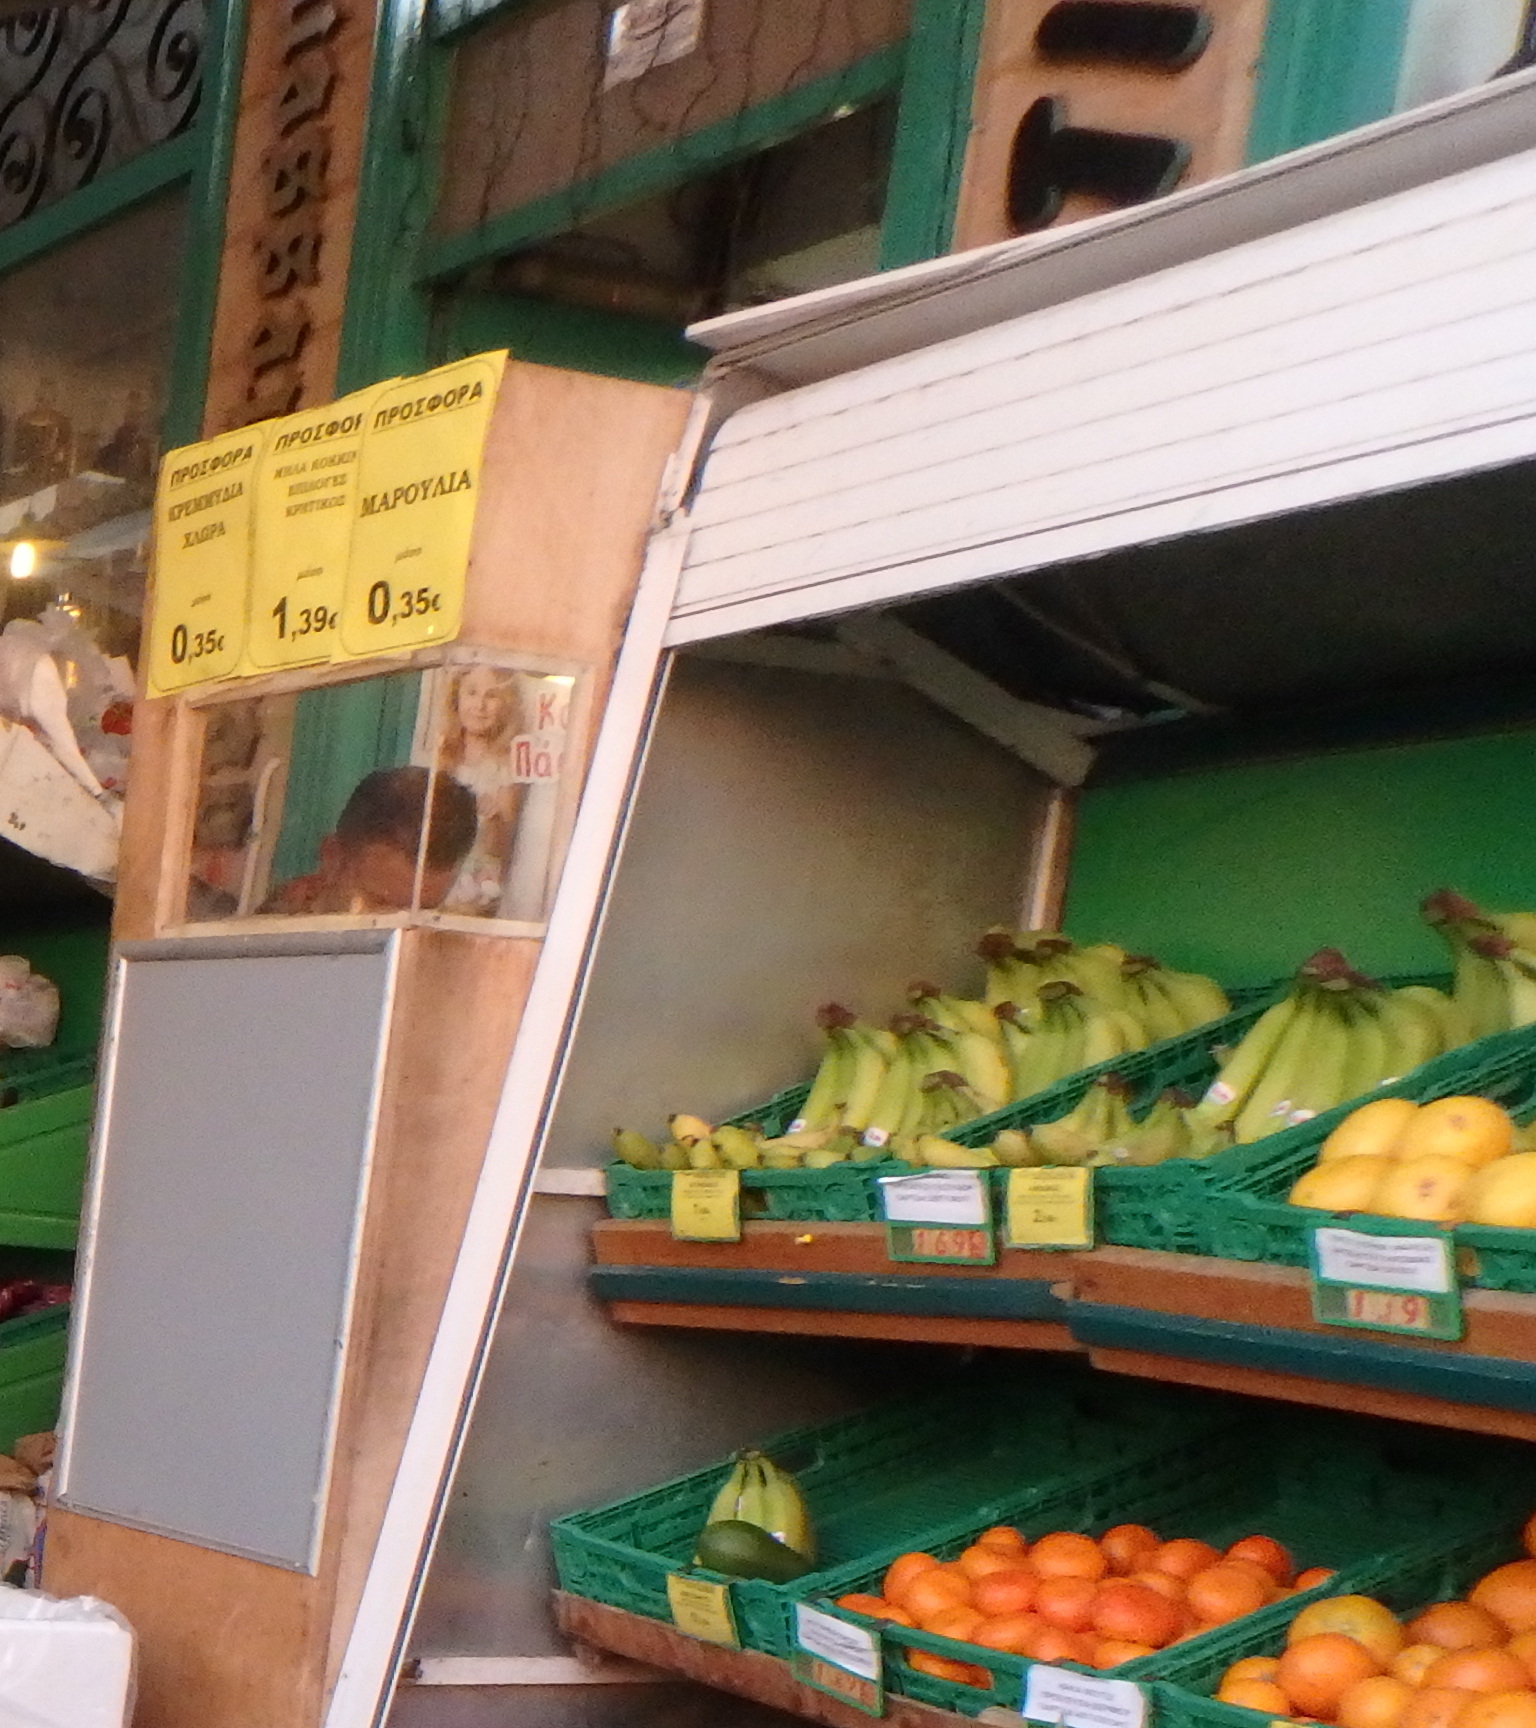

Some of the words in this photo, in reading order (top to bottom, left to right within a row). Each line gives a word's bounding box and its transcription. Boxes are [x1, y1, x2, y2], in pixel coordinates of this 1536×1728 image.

[373, 380, 483, 430] ΠΡΟΣΦΟΡΑ
[170, 445, 254, 487] ΠΡΟΣΦΟΡΑ
[360, 469, 472, 518] ΜΑΡΟΥΛΙΑ
